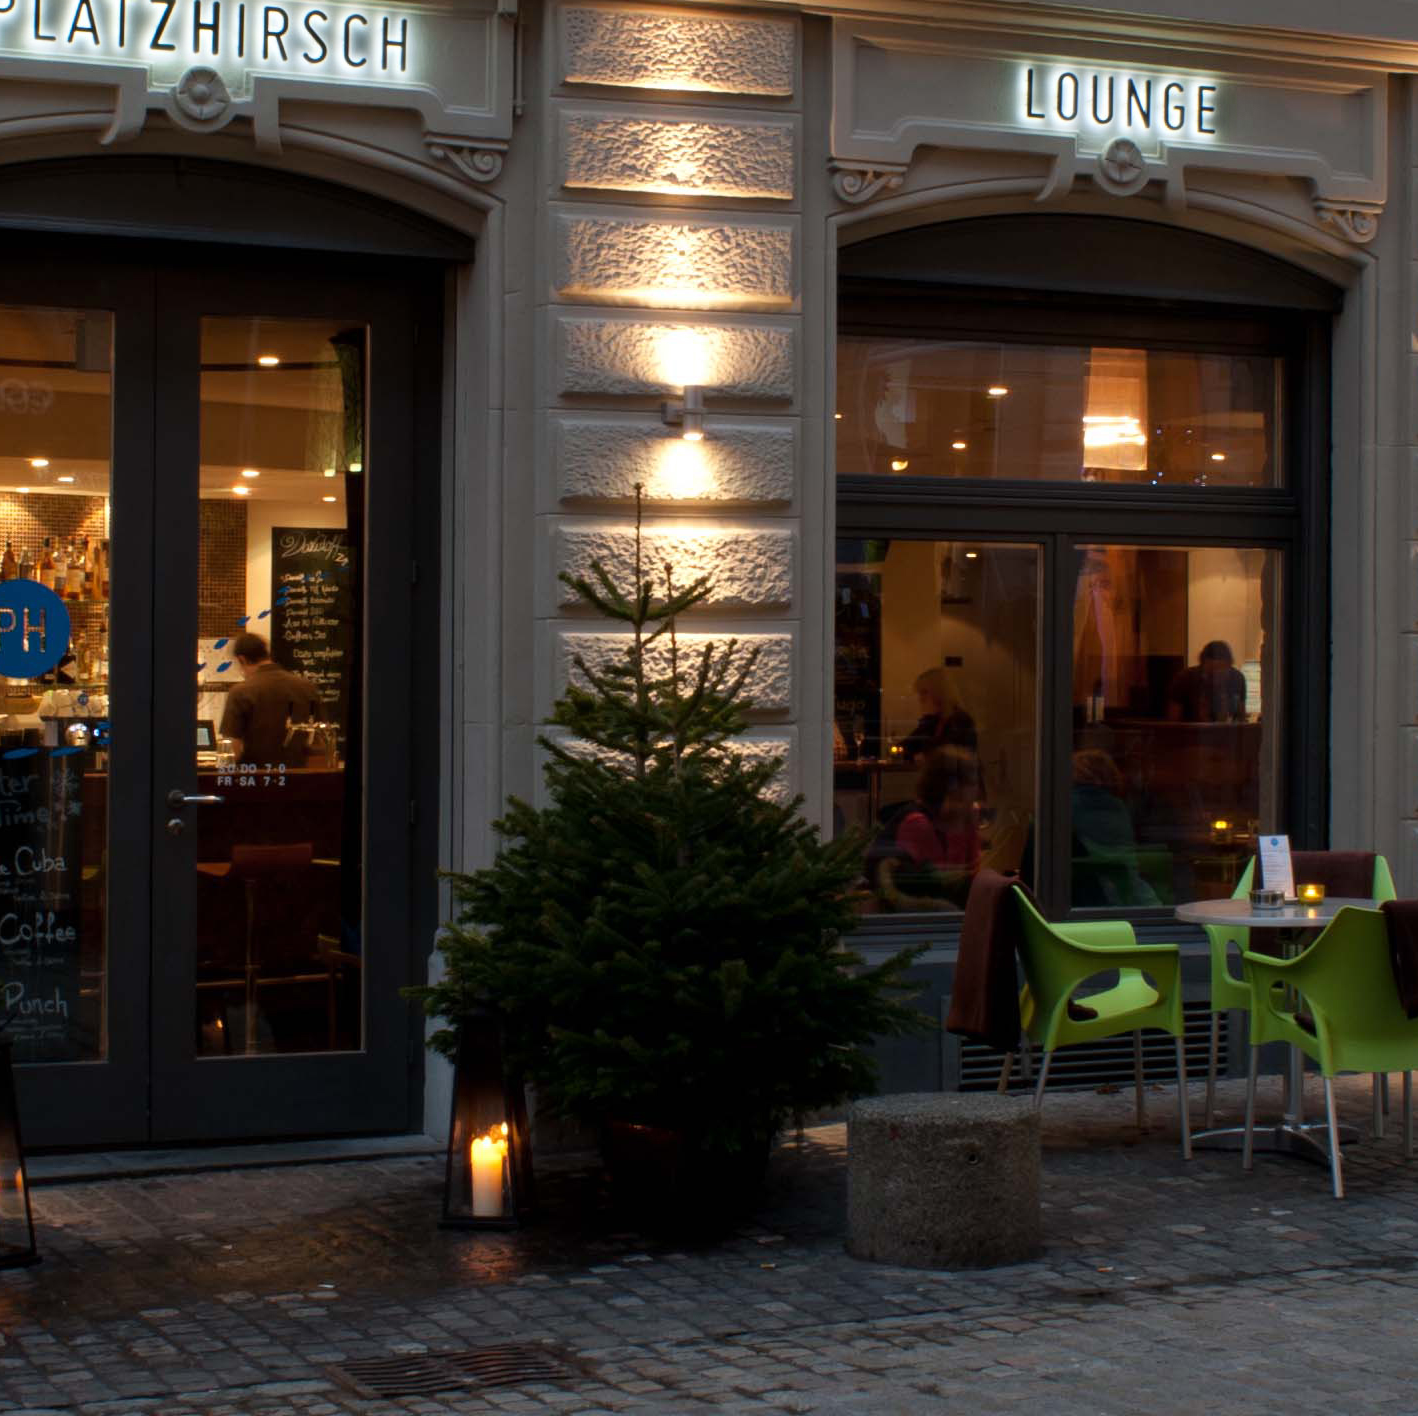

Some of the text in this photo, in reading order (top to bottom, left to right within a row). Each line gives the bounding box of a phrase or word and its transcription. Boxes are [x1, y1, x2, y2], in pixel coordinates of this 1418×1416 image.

[1027, 68, 1217, 134] LOUNGE
[14, 845, 69, 876] Cuba
[4, 981, 69, 1017] Punch
